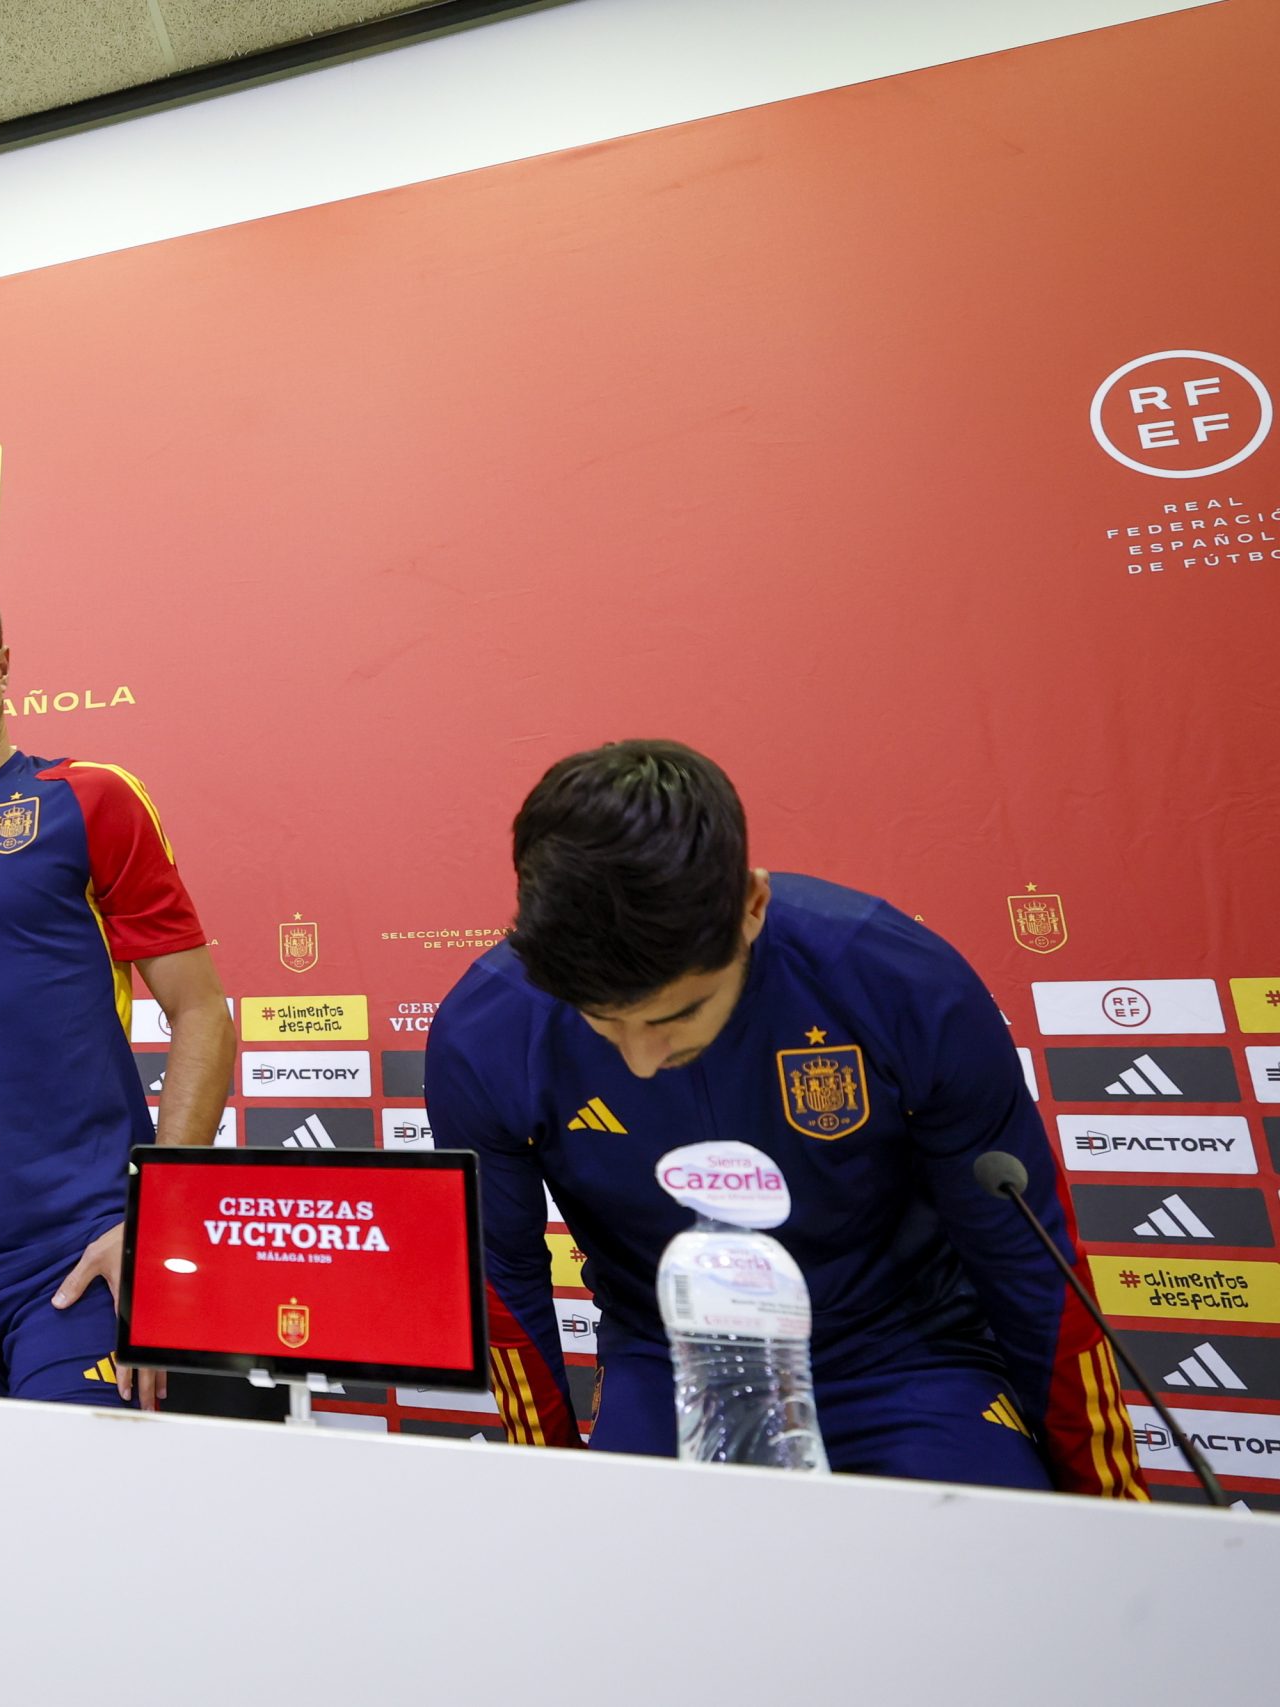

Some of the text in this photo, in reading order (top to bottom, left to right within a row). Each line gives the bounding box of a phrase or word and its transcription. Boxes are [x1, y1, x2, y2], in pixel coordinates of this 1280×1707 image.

[1164, 497, 1243, 514] REAL
[1106, 508, 1280, 539] FEDERACIÓ
[1129, 531, 1276, 556] ESPAÑOL
[1128, 548, 1280, 575] DE FÚTBO
[4, 685, 137, 717] AÑOLA
[381, 928, 460, 940] SELECCIÓN
[423, 941, 442, 949] DE
[261, 1003, 344, 1021] #alimentos
[278, 1016, 343, 1035] despaña
[707, 1155, 752, 1168] Sierra
[664, 1166, 783, 1192] Cazorla
[219, 1197, 375, 1221] CERVEZAS
[203, 1219, 391, 1252] VICTORIA
[256, 1250, 306, 1263] MÁLAGA
[1119, 1269, 1249, 1290] #alimentos
[1149, 1288, 1249, 1310] despaña
